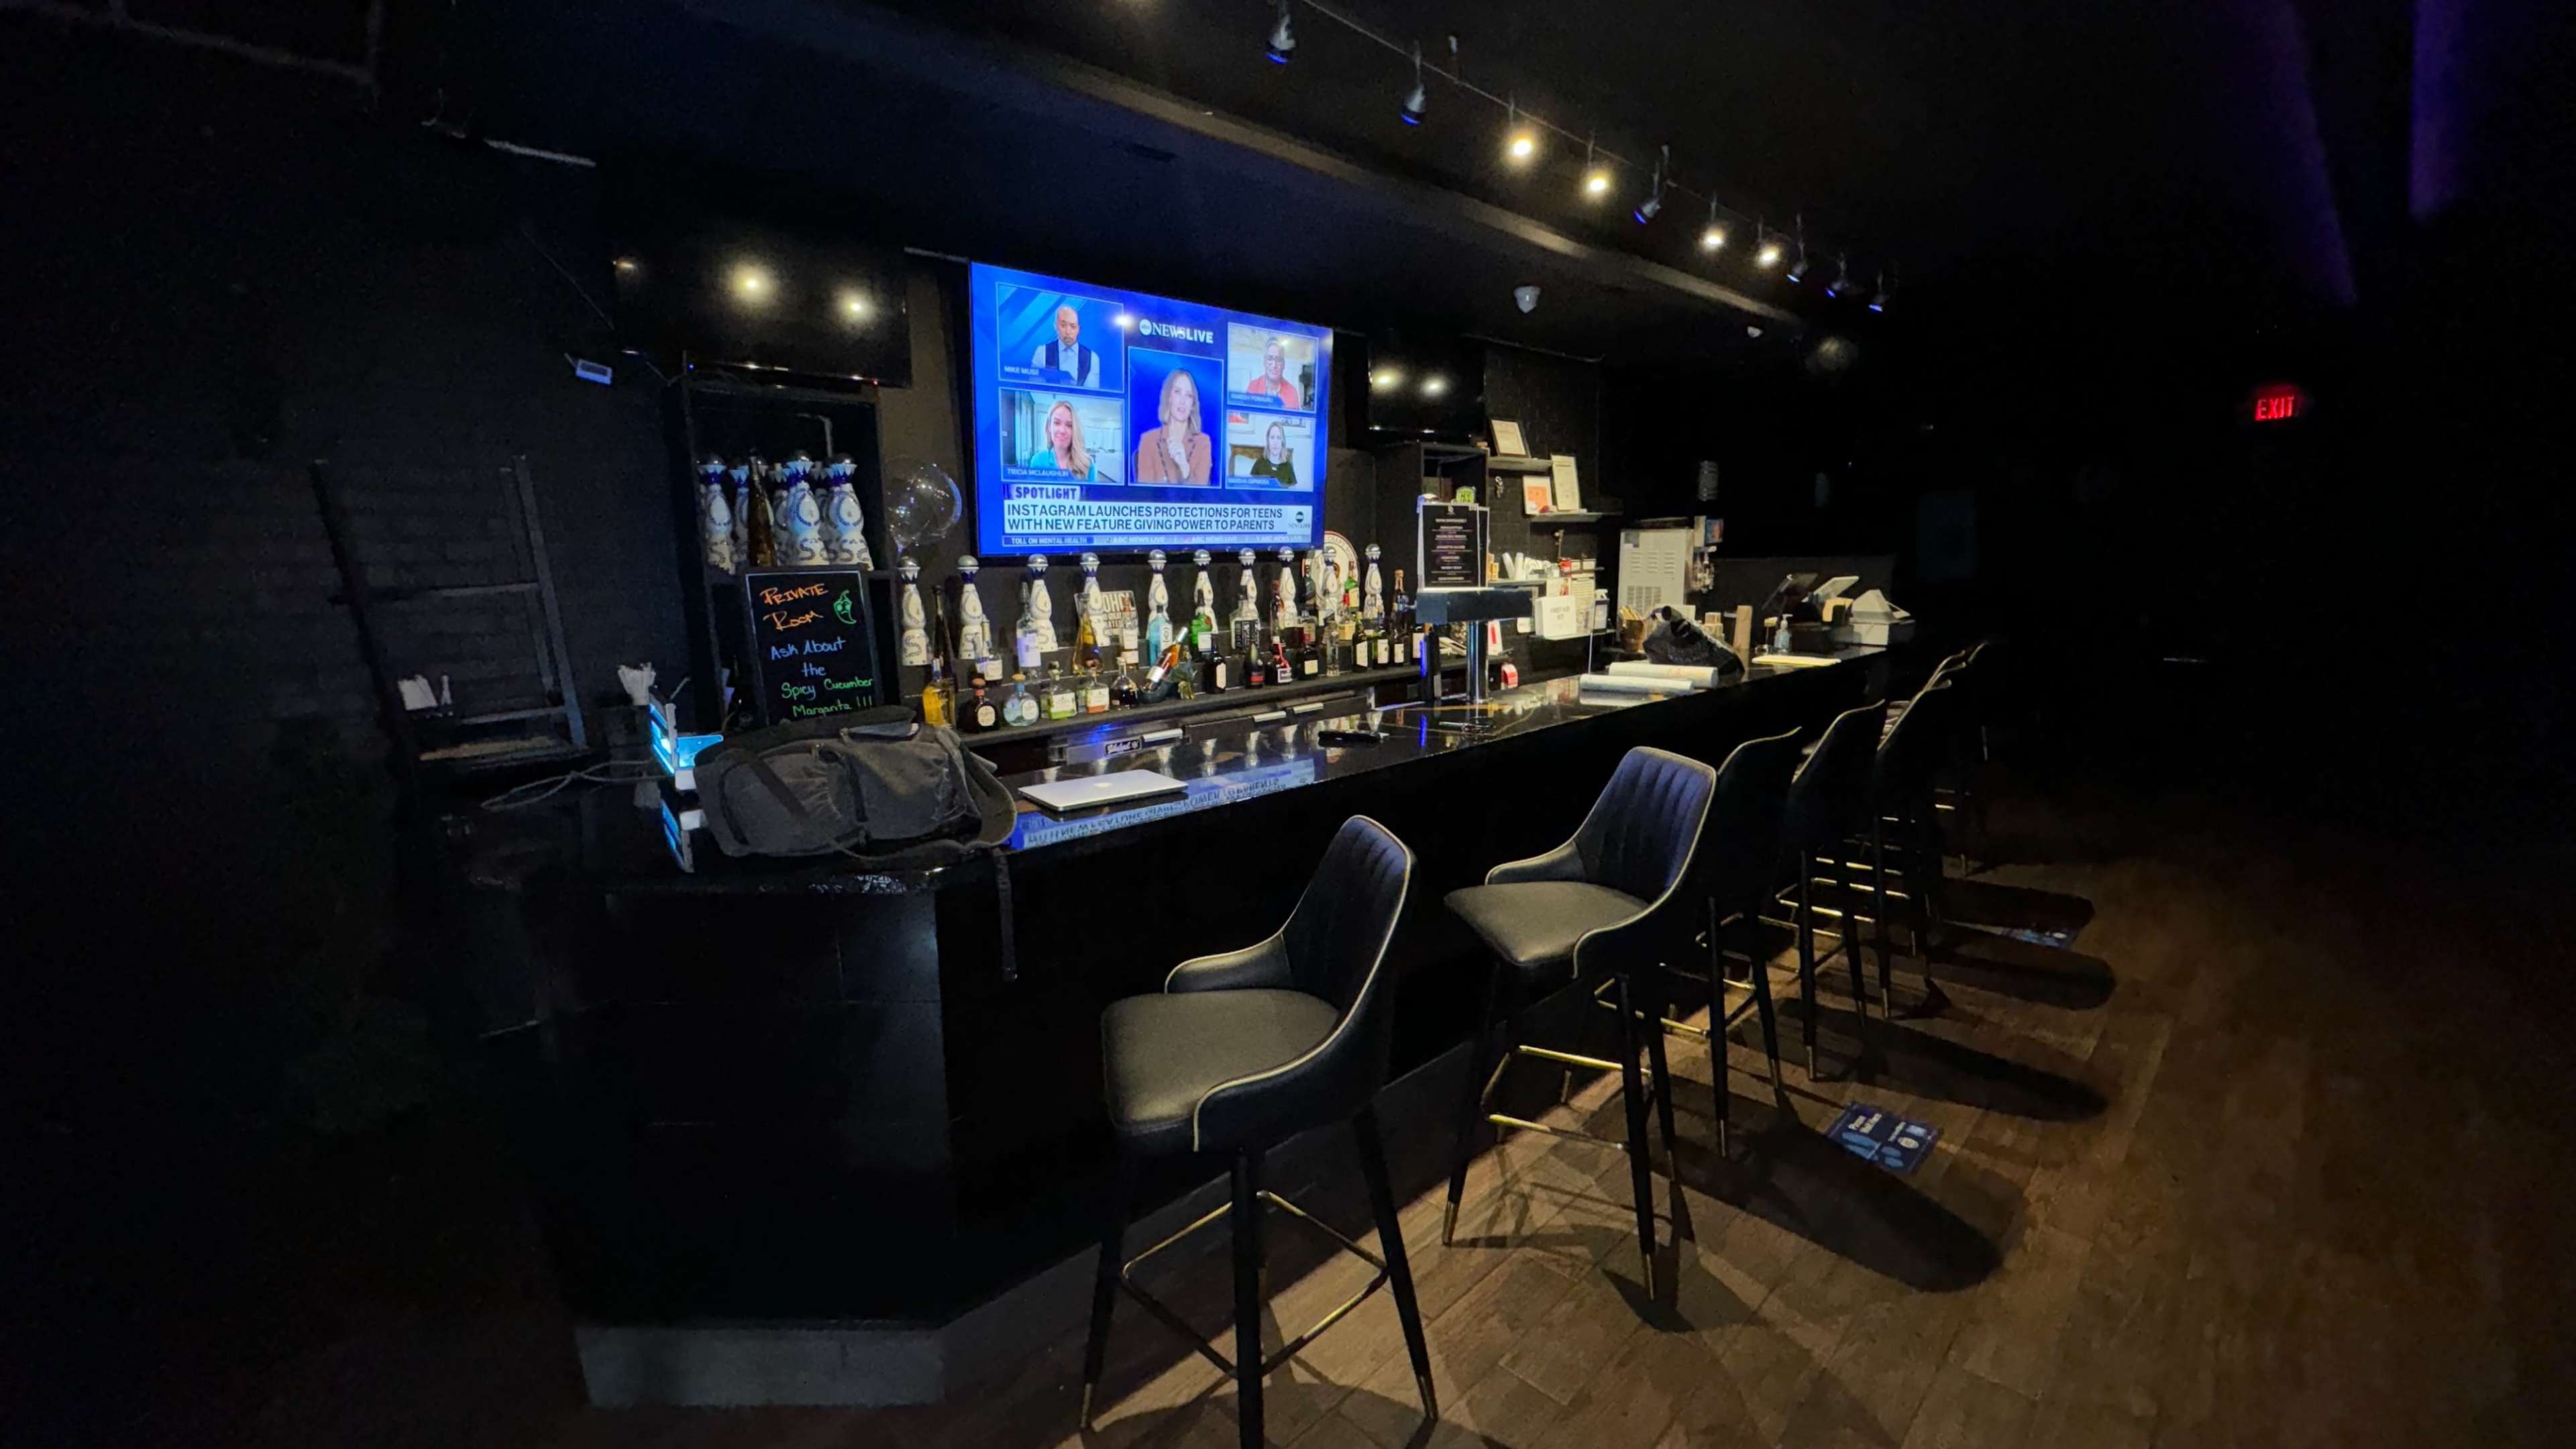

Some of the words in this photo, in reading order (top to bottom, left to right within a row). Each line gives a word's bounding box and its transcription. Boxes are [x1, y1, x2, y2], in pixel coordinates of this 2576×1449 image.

[2255, 396, 2294, 421] EXIT
[1015, 486, 1077, 499] SPOTLIGHT
[1008, 504, 1086, 517] INSTAGRAM
[1089, 506, 1152, 517] LAUNCHES
[1154, 506, 1229, 517] PROTECTIONS
[1231, 508, 1250, 517] FOR
[1253, 508, 1283, 518] TEENS
[1008, 519, 1042, 530] WITH
[1045, 519, 1075, 530] NEW
[1077, 519, 1132, 530] FEATURE
[1134, 519, 1172, 530] GIVING
[1175, 519, 1212, 530] POWER
[1215, 519, 1228, 530] TO
[1230, 519, 1275, 530] PARENTS
[771, 643, 799, 660] Ask
[803, 636, 847, 655] About
[801, 661, 826, 678] the
[781, 682, 816, 700] Spicy
[824, 676, 873, 690] Cucumber
